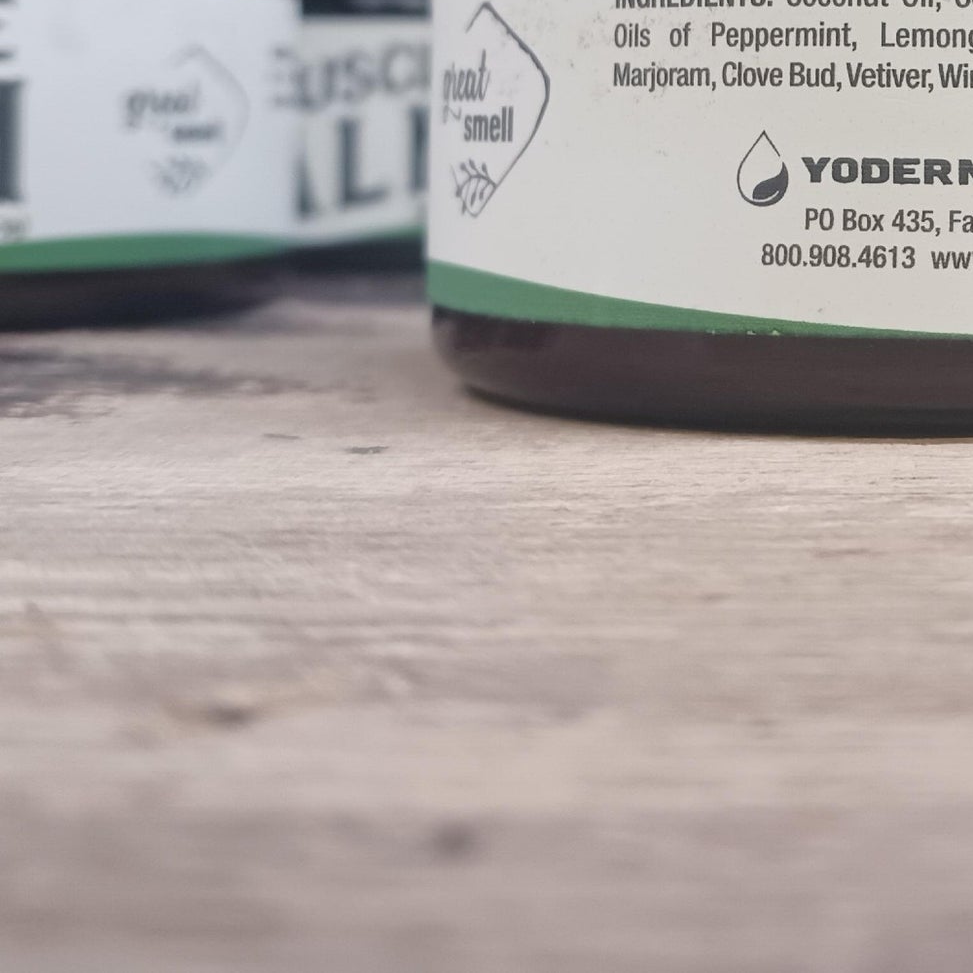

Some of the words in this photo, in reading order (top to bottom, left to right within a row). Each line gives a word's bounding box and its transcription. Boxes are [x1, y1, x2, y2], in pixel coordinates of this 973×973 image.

[614, 23, 651, 48] Oils
[669, 23, 691, 47] of
[711, 22, 858, 52] Peppermint,
[613, 63, 718, 92] Marjoram,
[722, 62, 783, 87] Clove
[789, 63, 843, 91] Bud,
[846, 63, 934, 93] Vetiver,
[463, 106, 514, 143] smell
[804, 208, 834, 231] PO
[843, 209, 885, 232] Box
[892, 209, 941, 236] 435,
[761, 244, 916, 269] 800.908.4613
